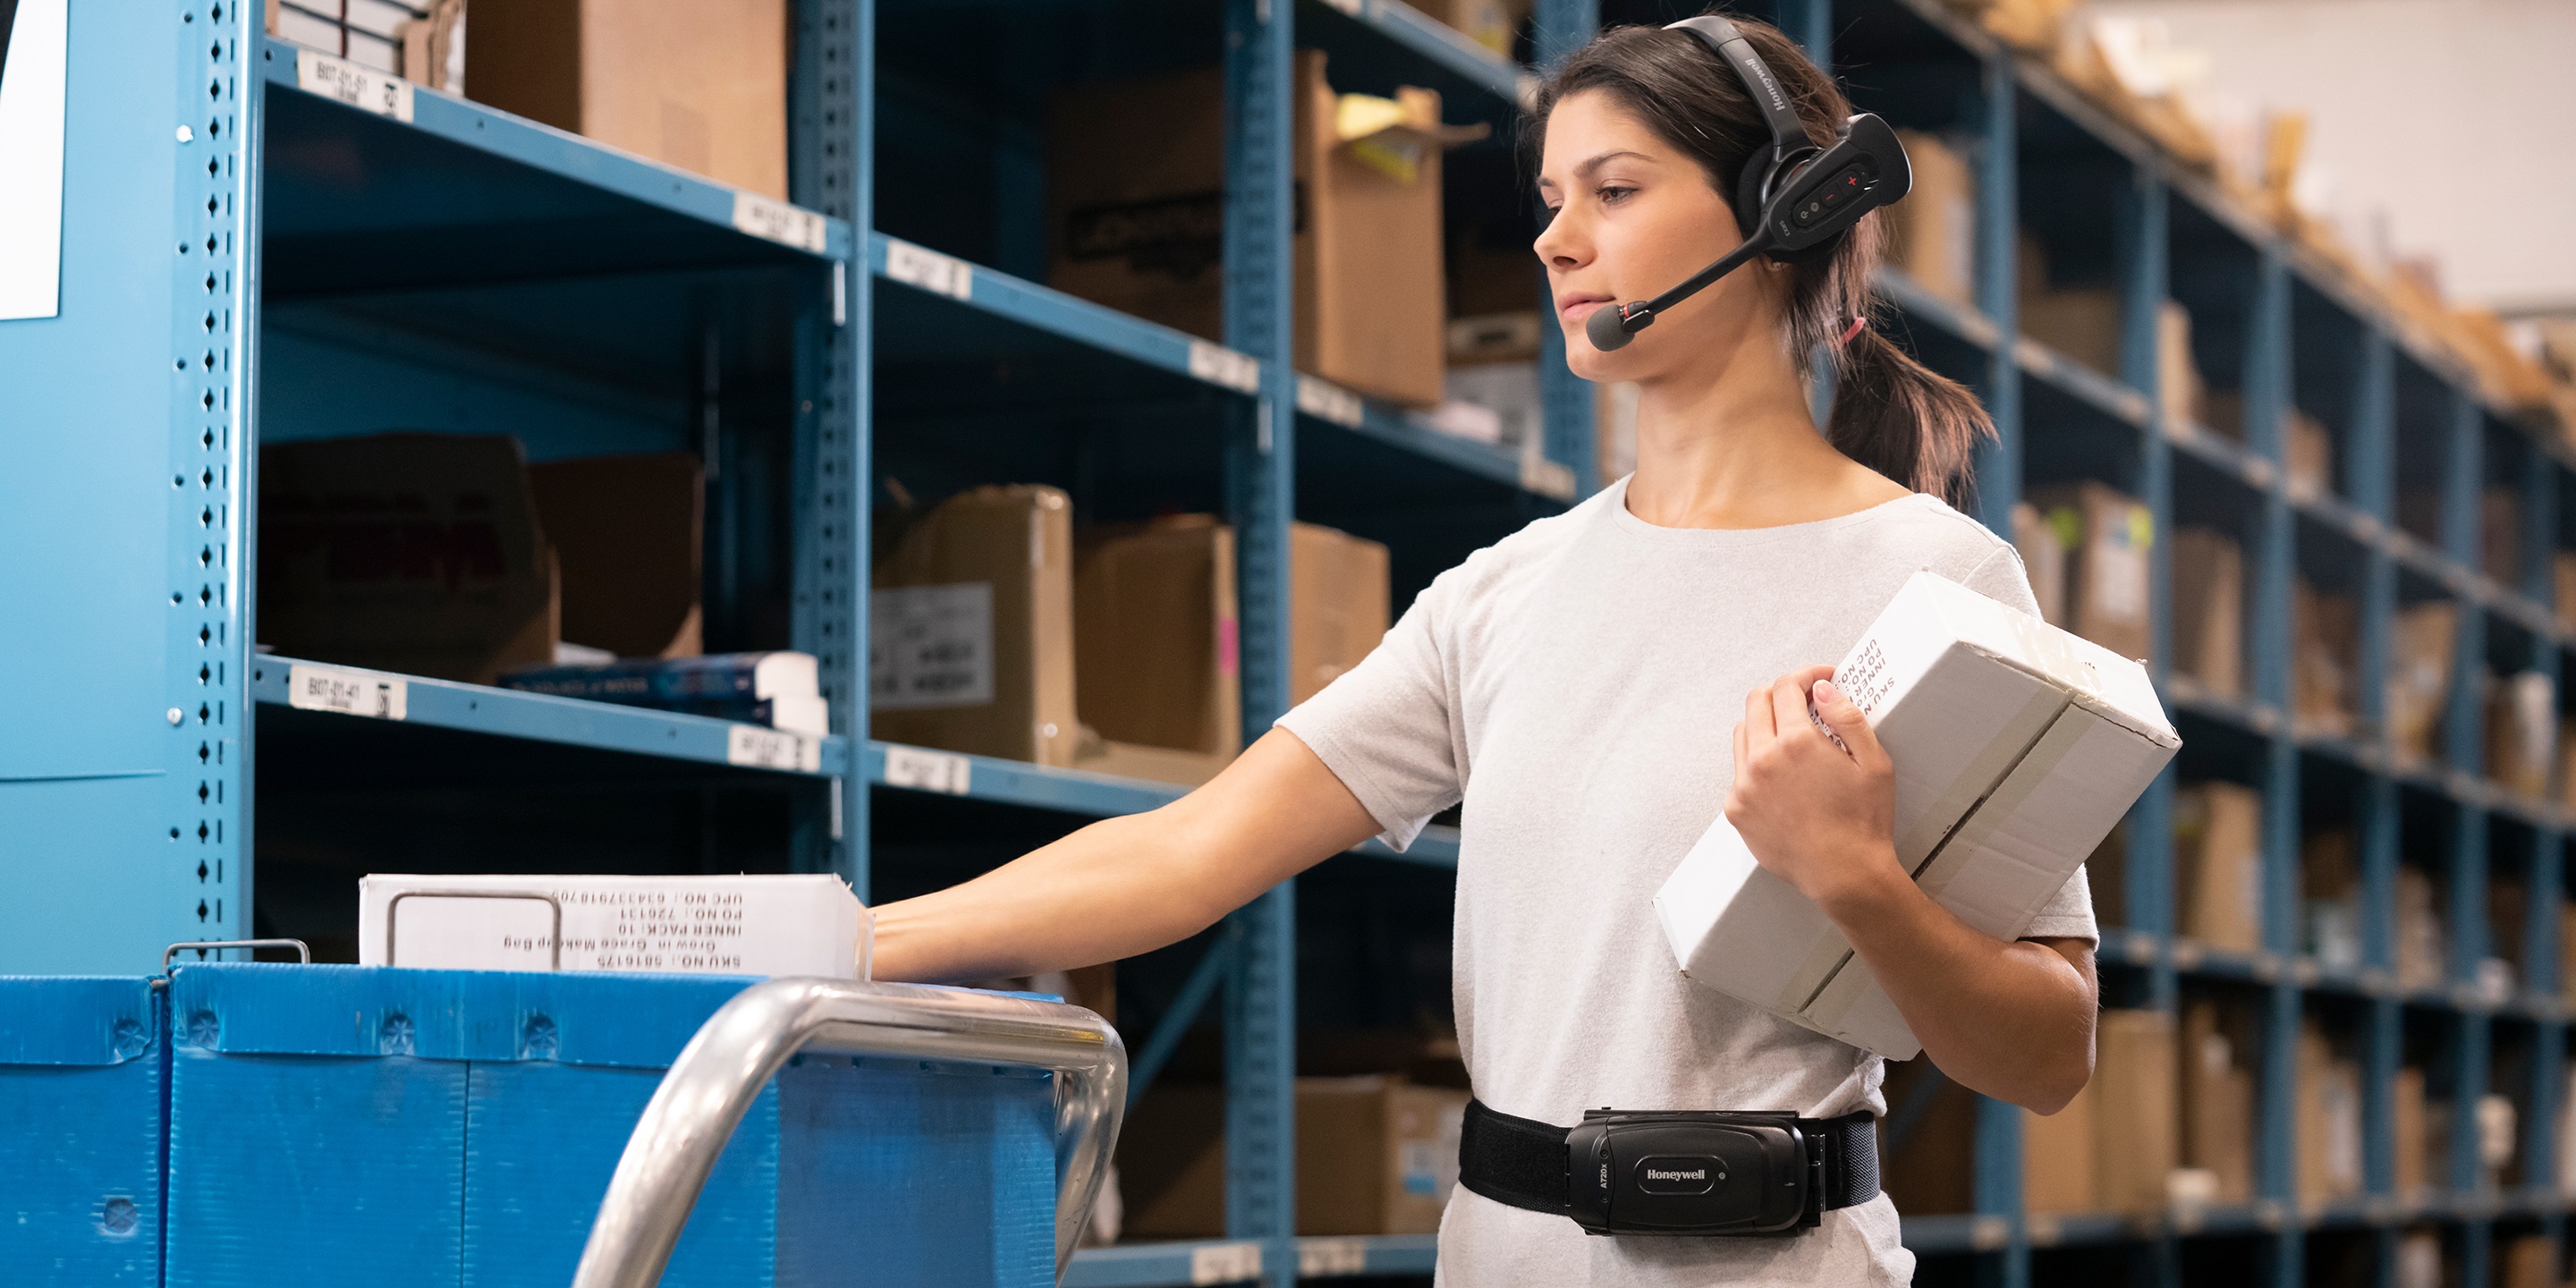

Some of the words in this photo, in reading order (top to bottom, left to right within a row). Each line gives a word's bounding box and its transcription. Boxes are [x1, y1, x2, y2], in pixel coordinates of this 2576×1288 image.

[1745, 58, 1785, 111] Honeywell
[1857, 639, 1877, 665] UPC
[1868, 648, 1882, 666] PO
[1835, 665, 1856, 690] NO.:
[1845, 665, 1867, 691] NO.:
[1854, 657, 1885, 697] INNER
[1857, 687, 1875, 708] Gro
[1873, 677, 1894, 705] SKU
[1863, 703, 1872, 716] N
[713, 893, 743, 905] UPC
[620, 908, 674, 921] 726131
[724, 909, 742, 921] PO
[618, 923, 635, 936] 10
[640, 924, 689, 936] PACK:
[693, 925, 741, 937] INNER
[504, 936, 532, 951] Bag
[601, 938, 648, 951] Grace
[657, 938, 672, 950] in
[676, 939, 716, 952] Grow
[597, 955, 662, 968] 5816175
[708, 956, 741, 969] SKU
[1647, 1169, 1705, 1182] Honeywell
